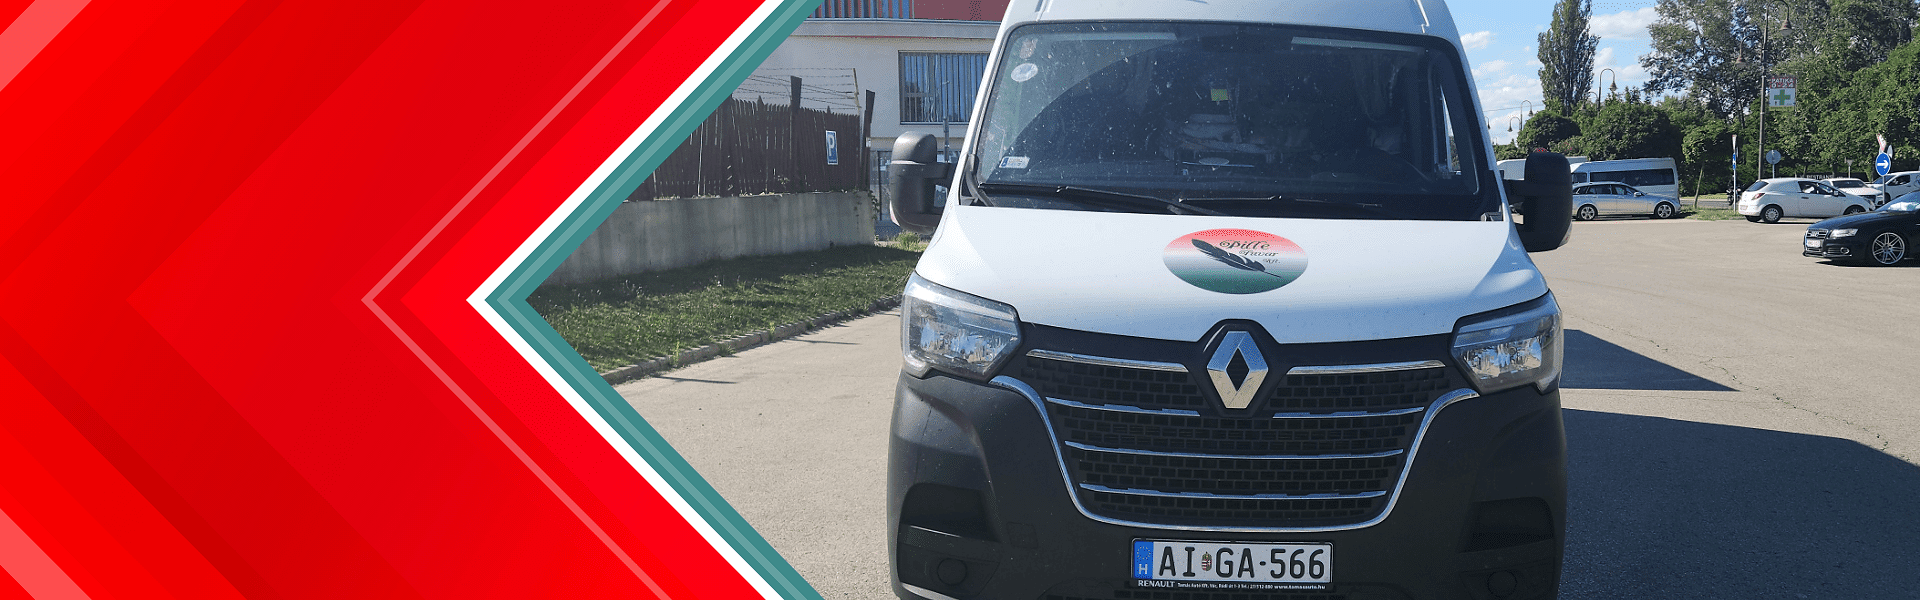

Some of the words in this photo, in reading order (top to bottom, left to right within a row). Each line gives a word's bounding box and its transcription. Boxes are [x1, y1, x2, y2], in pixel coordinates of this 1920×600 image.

[828, 134, 835, 157] P
[1138, 563, 1148, 575] H
[1158, 545, 1196, 578] AI
[1215, 546, 1325, 580] GA-566
[1137, 579, 1176, 588] RENAULT
